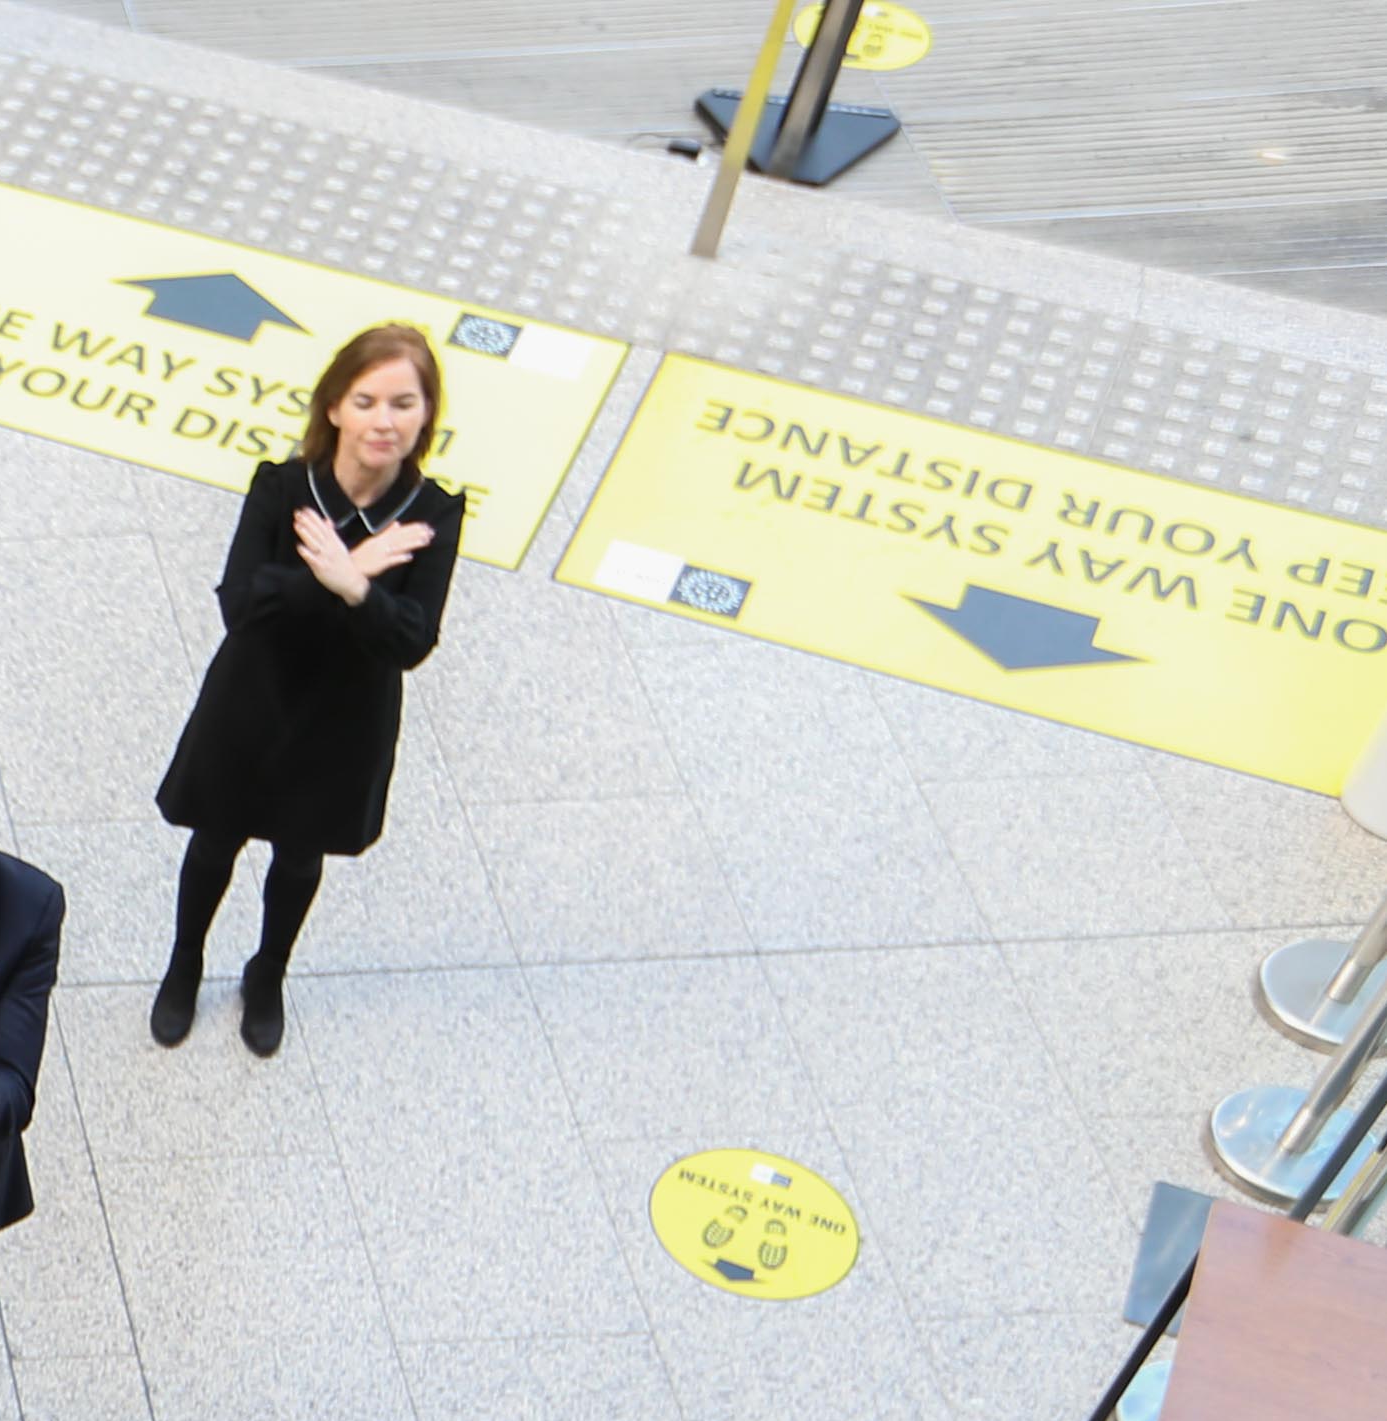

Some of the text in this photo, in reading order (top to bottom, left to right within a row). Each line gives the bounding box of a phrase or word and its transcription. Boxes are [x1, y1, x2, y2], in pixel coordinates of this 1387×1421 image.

[49, 322, 198, 382] WAY
[695, 398, 1033, 513] DISTANCE
[733, 460, 1387, 655] ONE WAY SYSTEM
[1057, 491, 1259, 573] YOUR
[678, 1168, 848, 1235] ONE WAY SYSTEM
